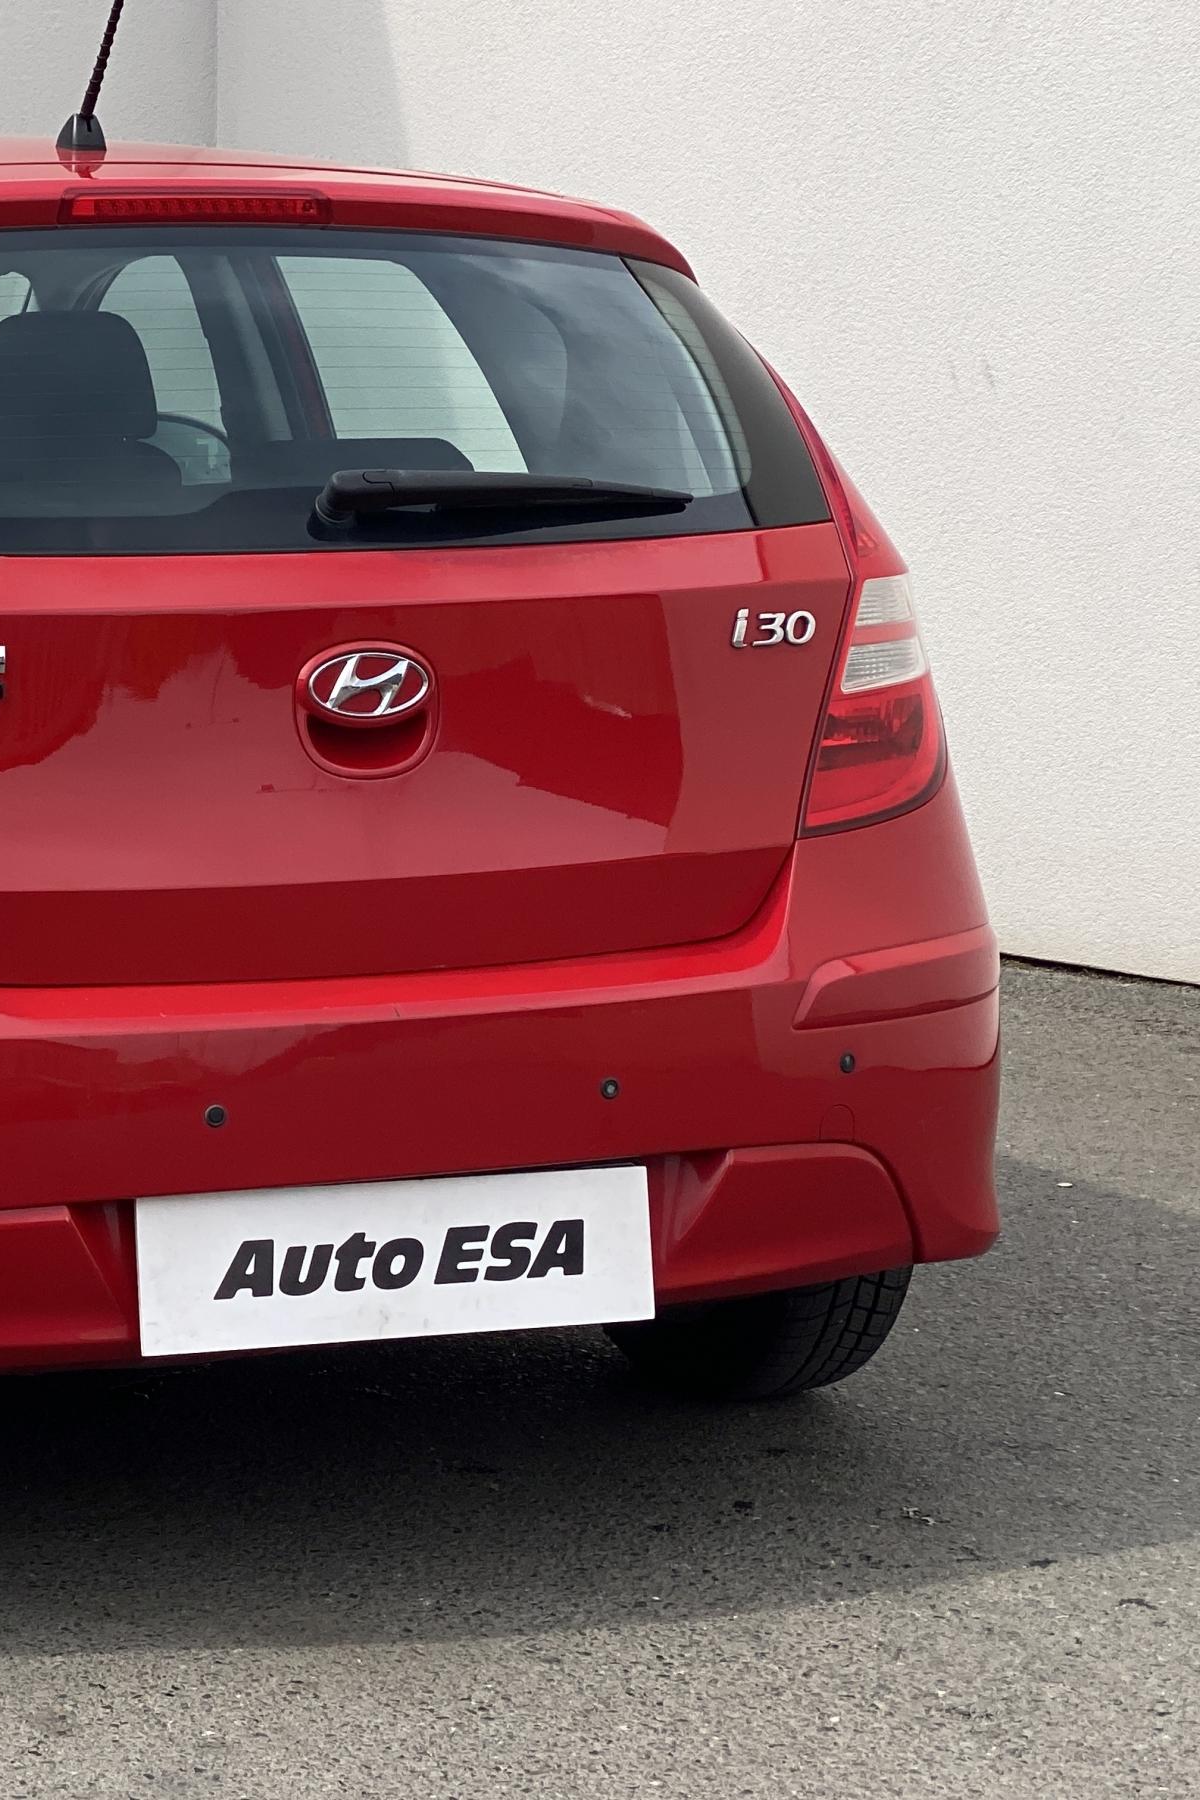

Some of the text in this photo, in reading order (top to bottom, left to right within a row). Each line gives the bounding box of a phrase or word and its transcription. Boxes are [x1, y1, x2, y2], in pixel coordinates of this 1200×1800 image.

[732, 608, 816, 647] i30
[213, 1218, 585, 1301] Auto ESA
